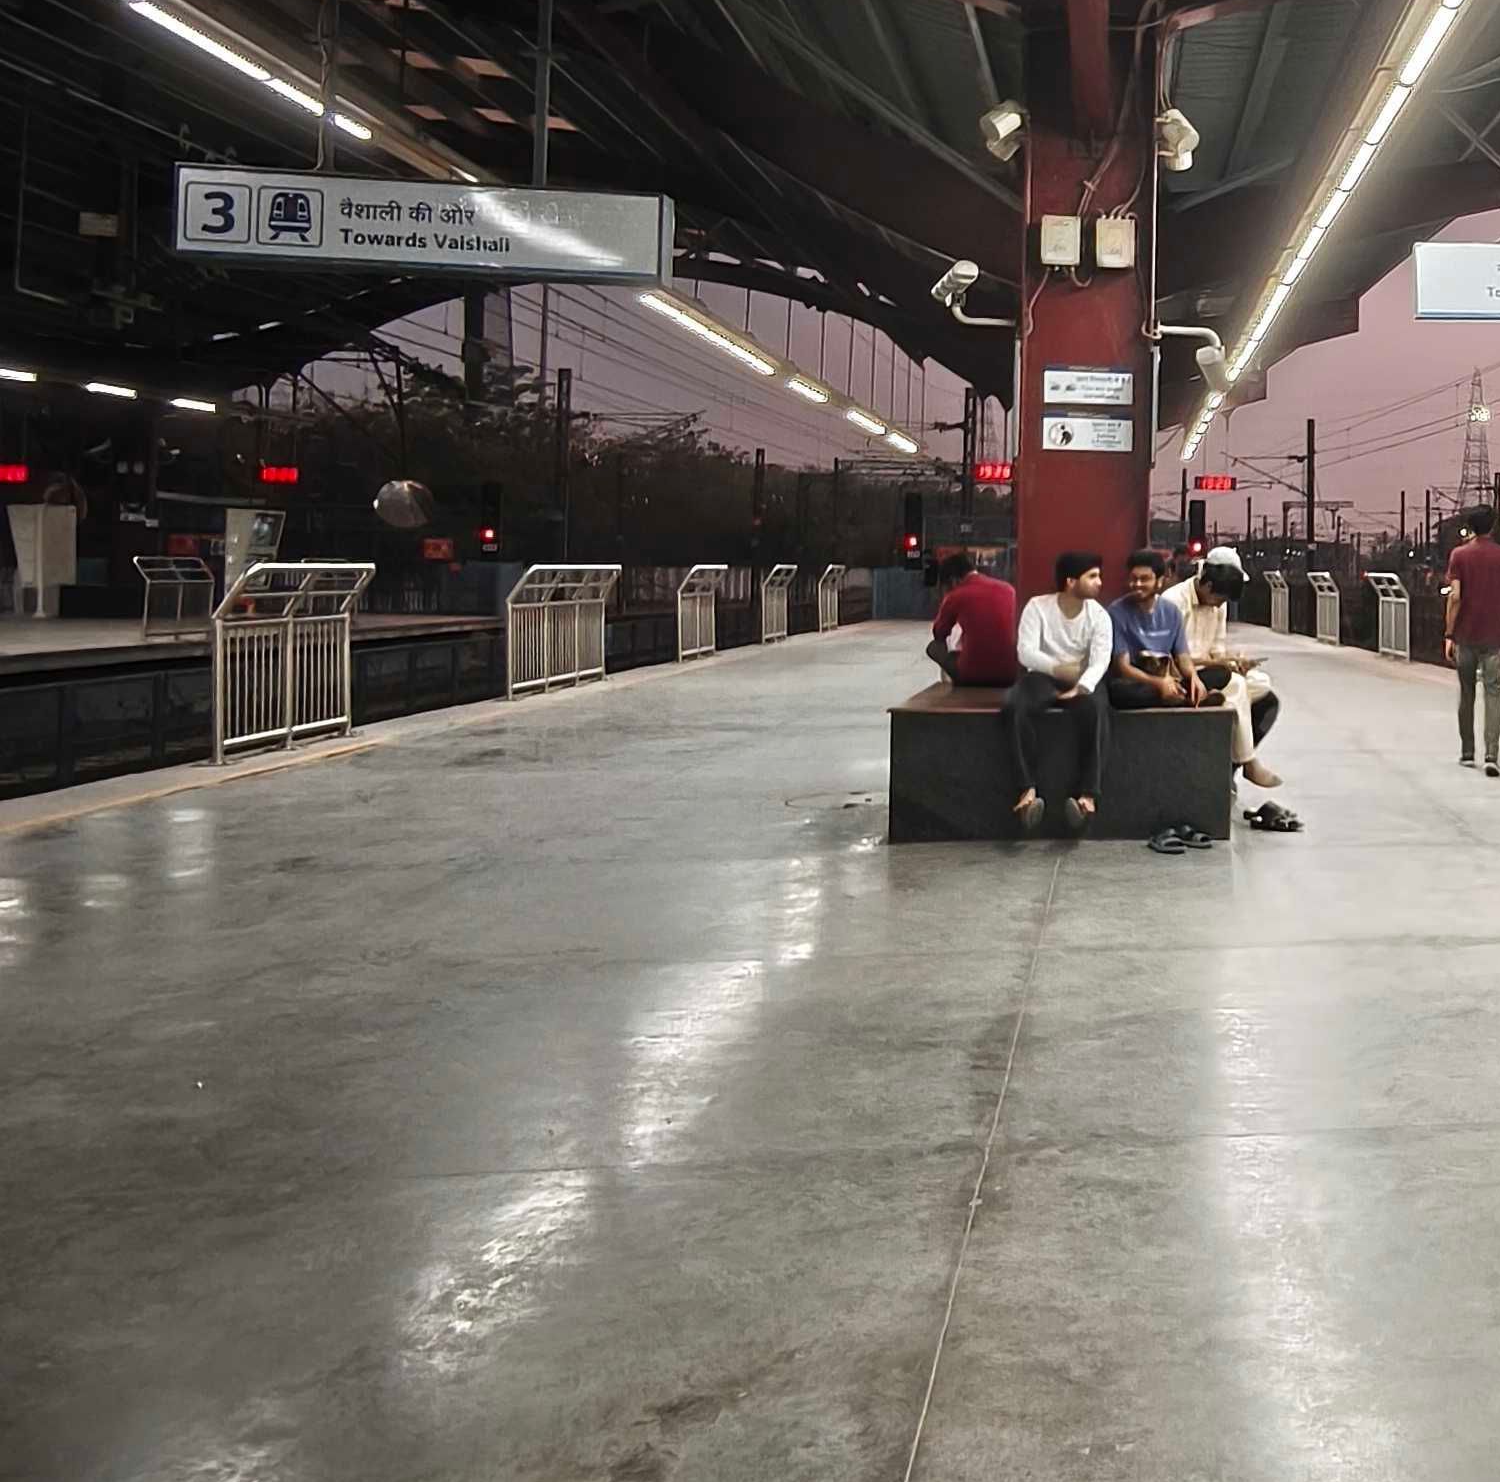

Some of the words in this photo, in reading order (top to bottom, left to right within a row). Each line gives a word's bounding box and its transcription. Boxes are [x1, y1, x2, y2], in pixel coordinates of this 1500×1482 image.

[200, 191, 236, 235] 3
[340, 197, 401, 222] वैशाली
[409, 201, 432, 224] की
[440, 203, 476, 226] ओर
[339, 228, 428, 249] Towards
